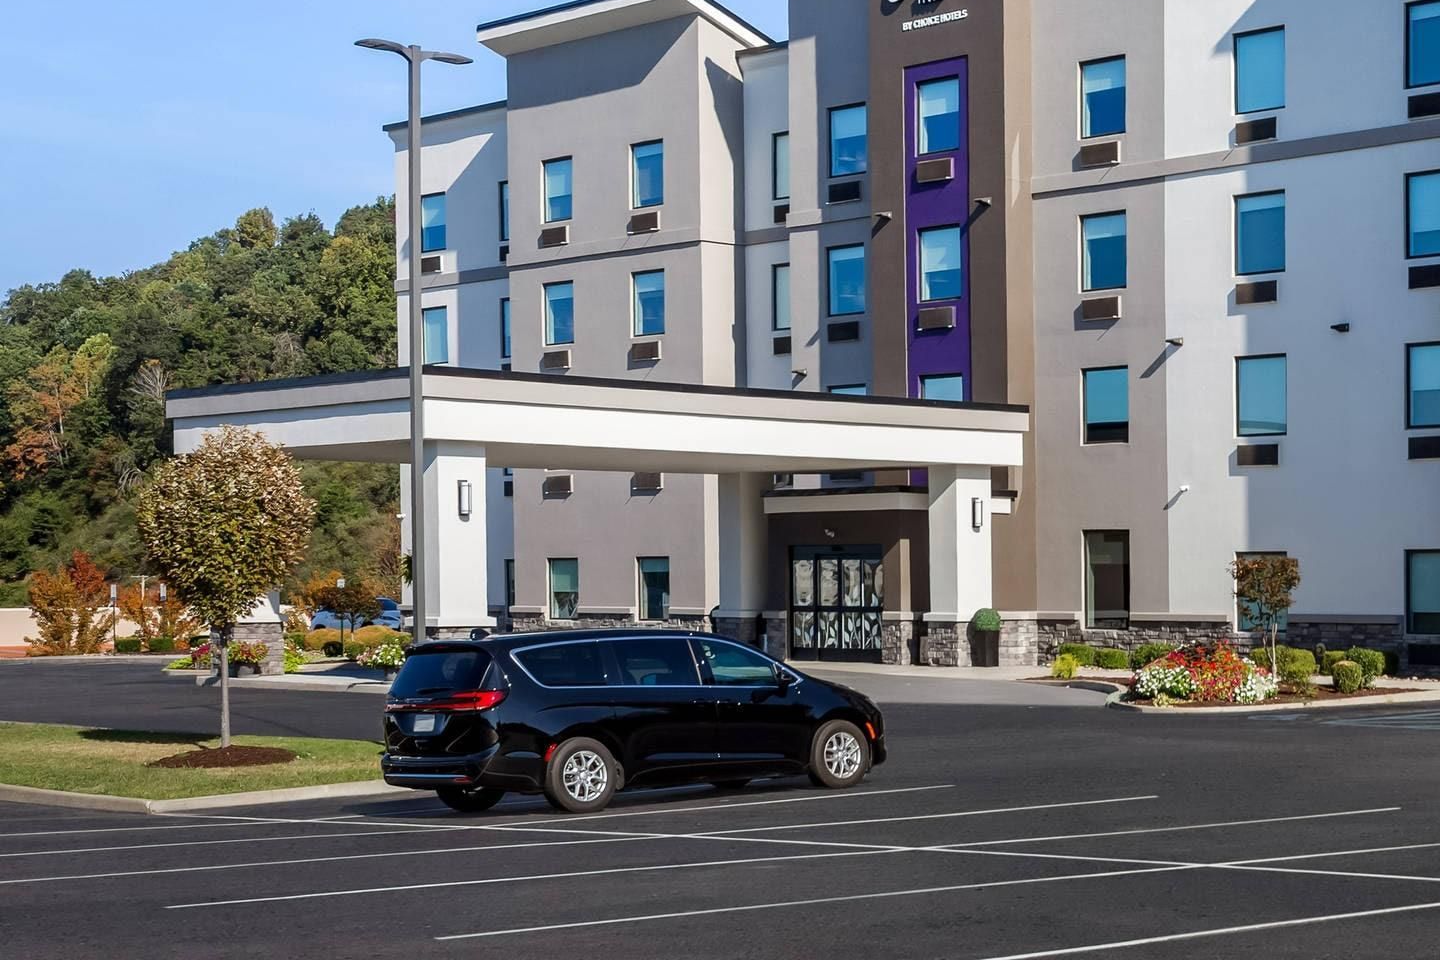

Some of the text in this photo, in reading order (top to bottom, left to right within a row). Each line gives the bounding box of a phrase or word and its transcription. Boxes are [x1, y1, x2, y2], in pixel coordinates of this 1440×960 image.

[902, 9, 969, 32] BY CHOICE HOTELS
